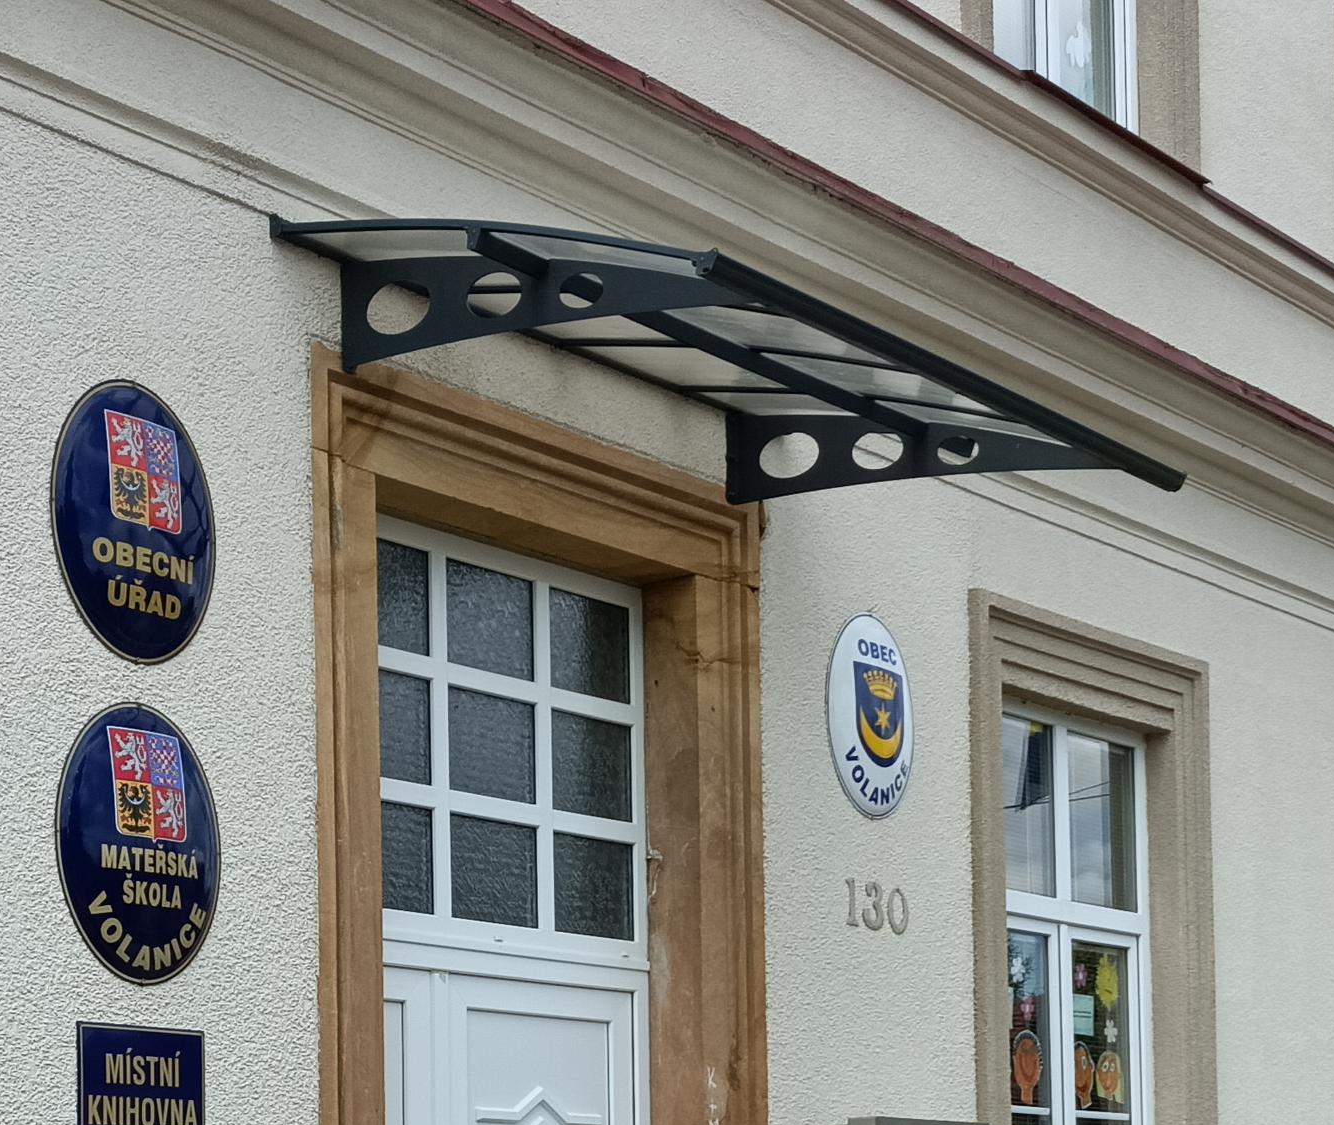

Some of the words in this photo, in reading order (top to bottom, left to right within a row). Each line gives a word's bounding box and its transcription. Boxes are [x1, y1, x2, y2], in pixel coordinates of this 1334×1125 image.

[92, 537, 194, 585] OBECNÍ
[107, 575, 182, 620] ÚŘAD
[857, 638, 897, 666] OBEC
[845, 746, 909, 806] VOLANICE
[100, 843, 198, 880] MATEŘSKÁ
[122, 873, 182, 909] ŠKOLA
[845, 877, 909, 935] 130
[88, 890, 207, 971] VOLANICE
[105, 1047, 181, 1088] MÍSTNÍ
